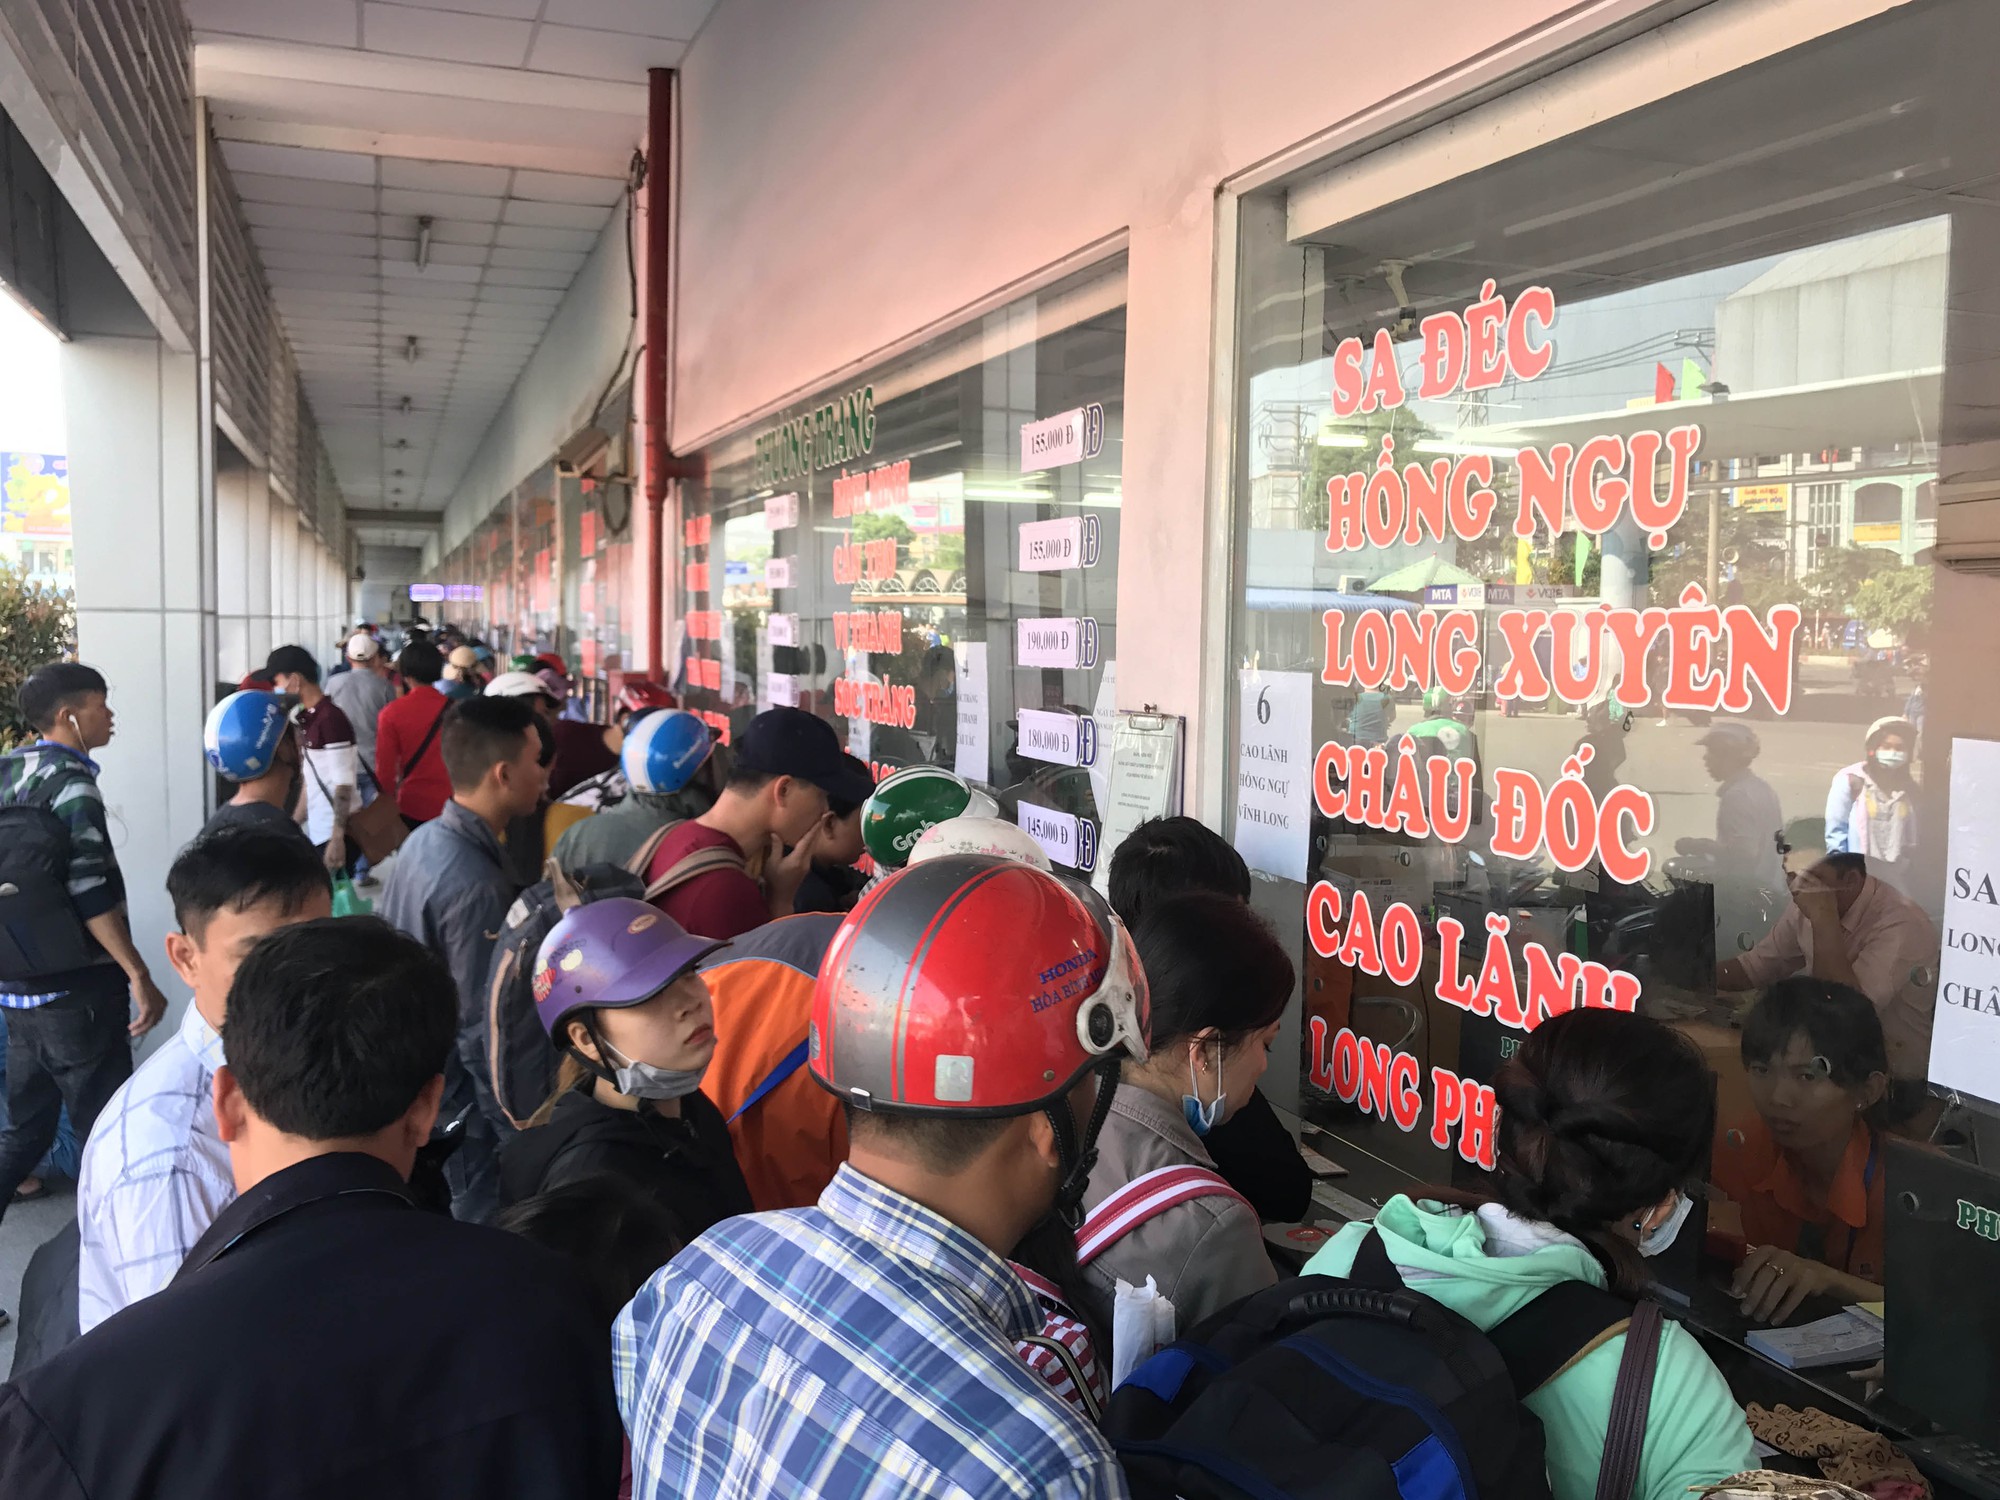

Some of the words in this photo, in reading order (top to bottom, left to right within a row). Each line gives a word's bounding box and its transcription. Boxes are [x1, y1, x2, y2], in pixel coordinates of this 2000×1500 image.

[1331, 327, 1405, 419] SA
[1418, 278, 1555, 401] ĐÉC
[1032, 427, 1064, 455] 155,000
[1326, 434, 1497, 553] HỒNG
[1513, 424, 1701, 550] NGỰ
[1029, 539, 1061, 561] 155,000
[1027, 631, 1059, 651] 190,000
[1320, 608, 1481, 696] LONG
[1496, 582, 1801, 715] XUYÊN
[1256, 684, 1271, 725] 6
[1028, 729, 1059, 751] 180,000
[1240, 744, 1259, 759] CAO
[1263, 810, 1290, 830] LONG
[1313, 733, 1477, 844] CHÂU
[1491, 742, 1655, 885] ĐỐC
[1027, 816, 1059, 843] 145,000
[1953, 867, 2000, 906] SA
[1306, 879, 1423, 987] CAO
[1947, 928, 2000, 957] LON
[1039, 948, 1098, 985] HONDA
[1309, 1015, 1422, 1132] LONG
[1431, 1066, 1501, 1171] PH
[1957, 1199, 2000, 1241] PH
